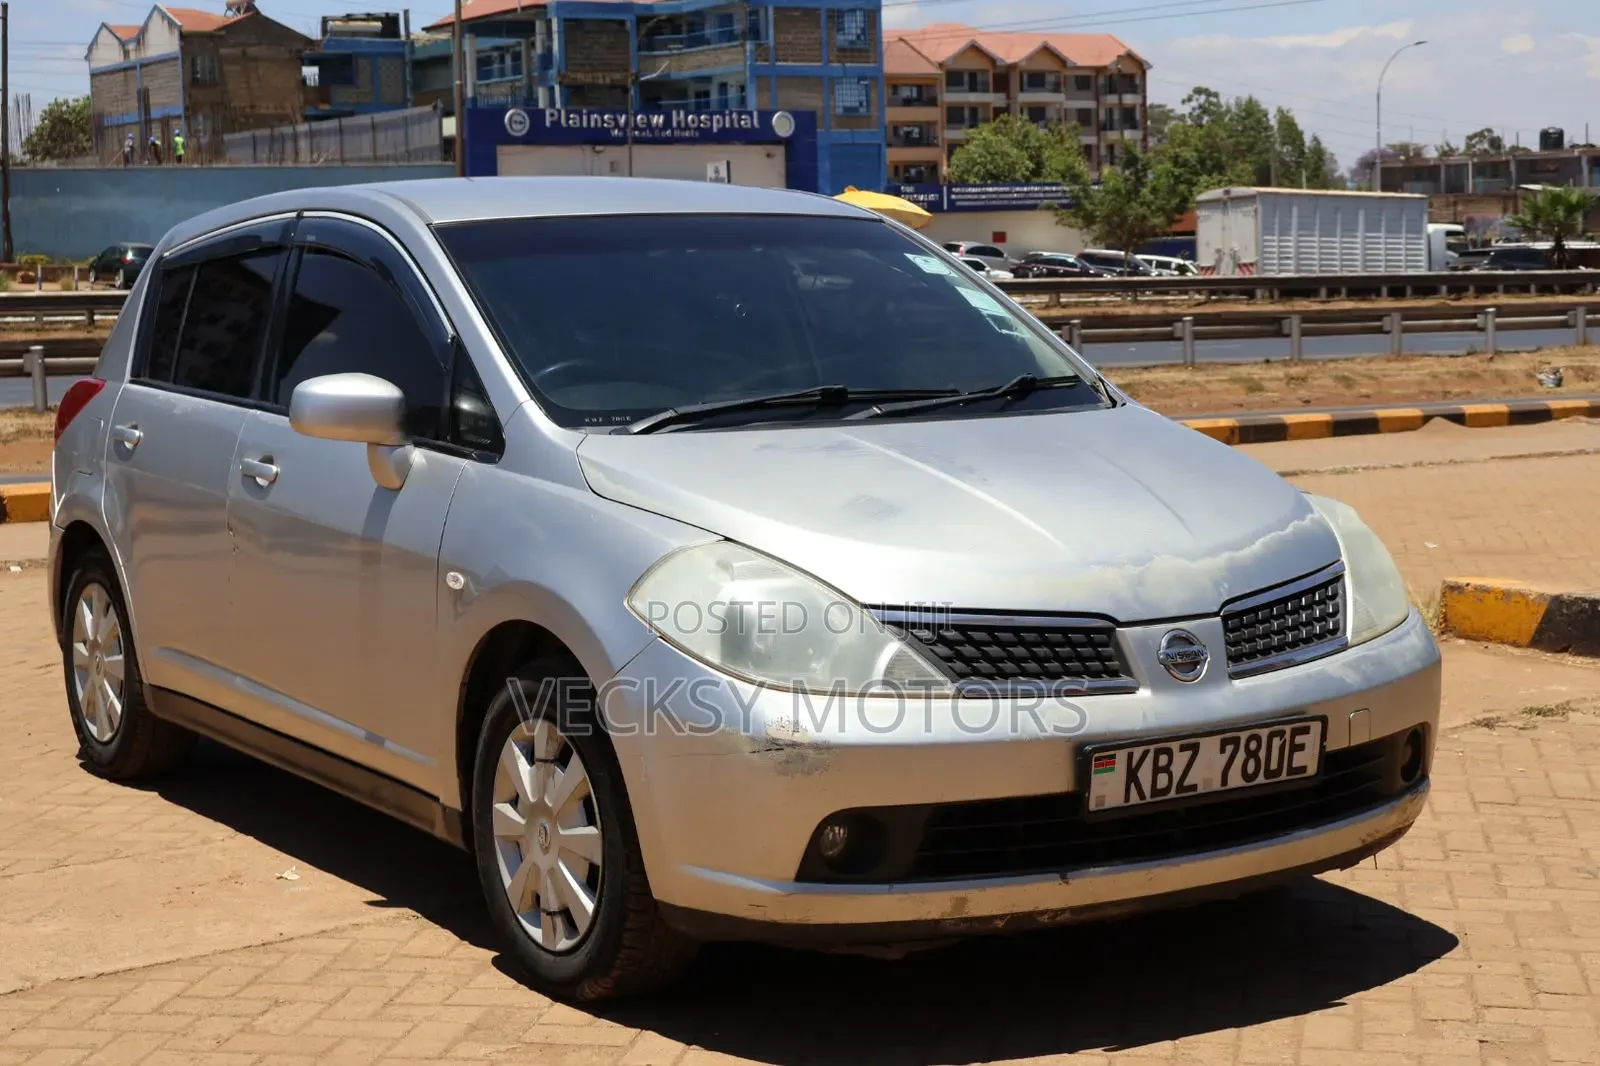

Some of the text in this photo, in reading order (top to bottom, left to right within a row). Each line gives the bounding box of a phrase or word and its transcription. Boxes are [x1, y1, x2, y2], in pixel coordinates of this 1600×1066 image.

[545, 107, 760, 134] Plainsview Hospital
[1165, 648, 1205, 661] NISSAN
[1123, 725, 1311, 804] KBZ 780E
